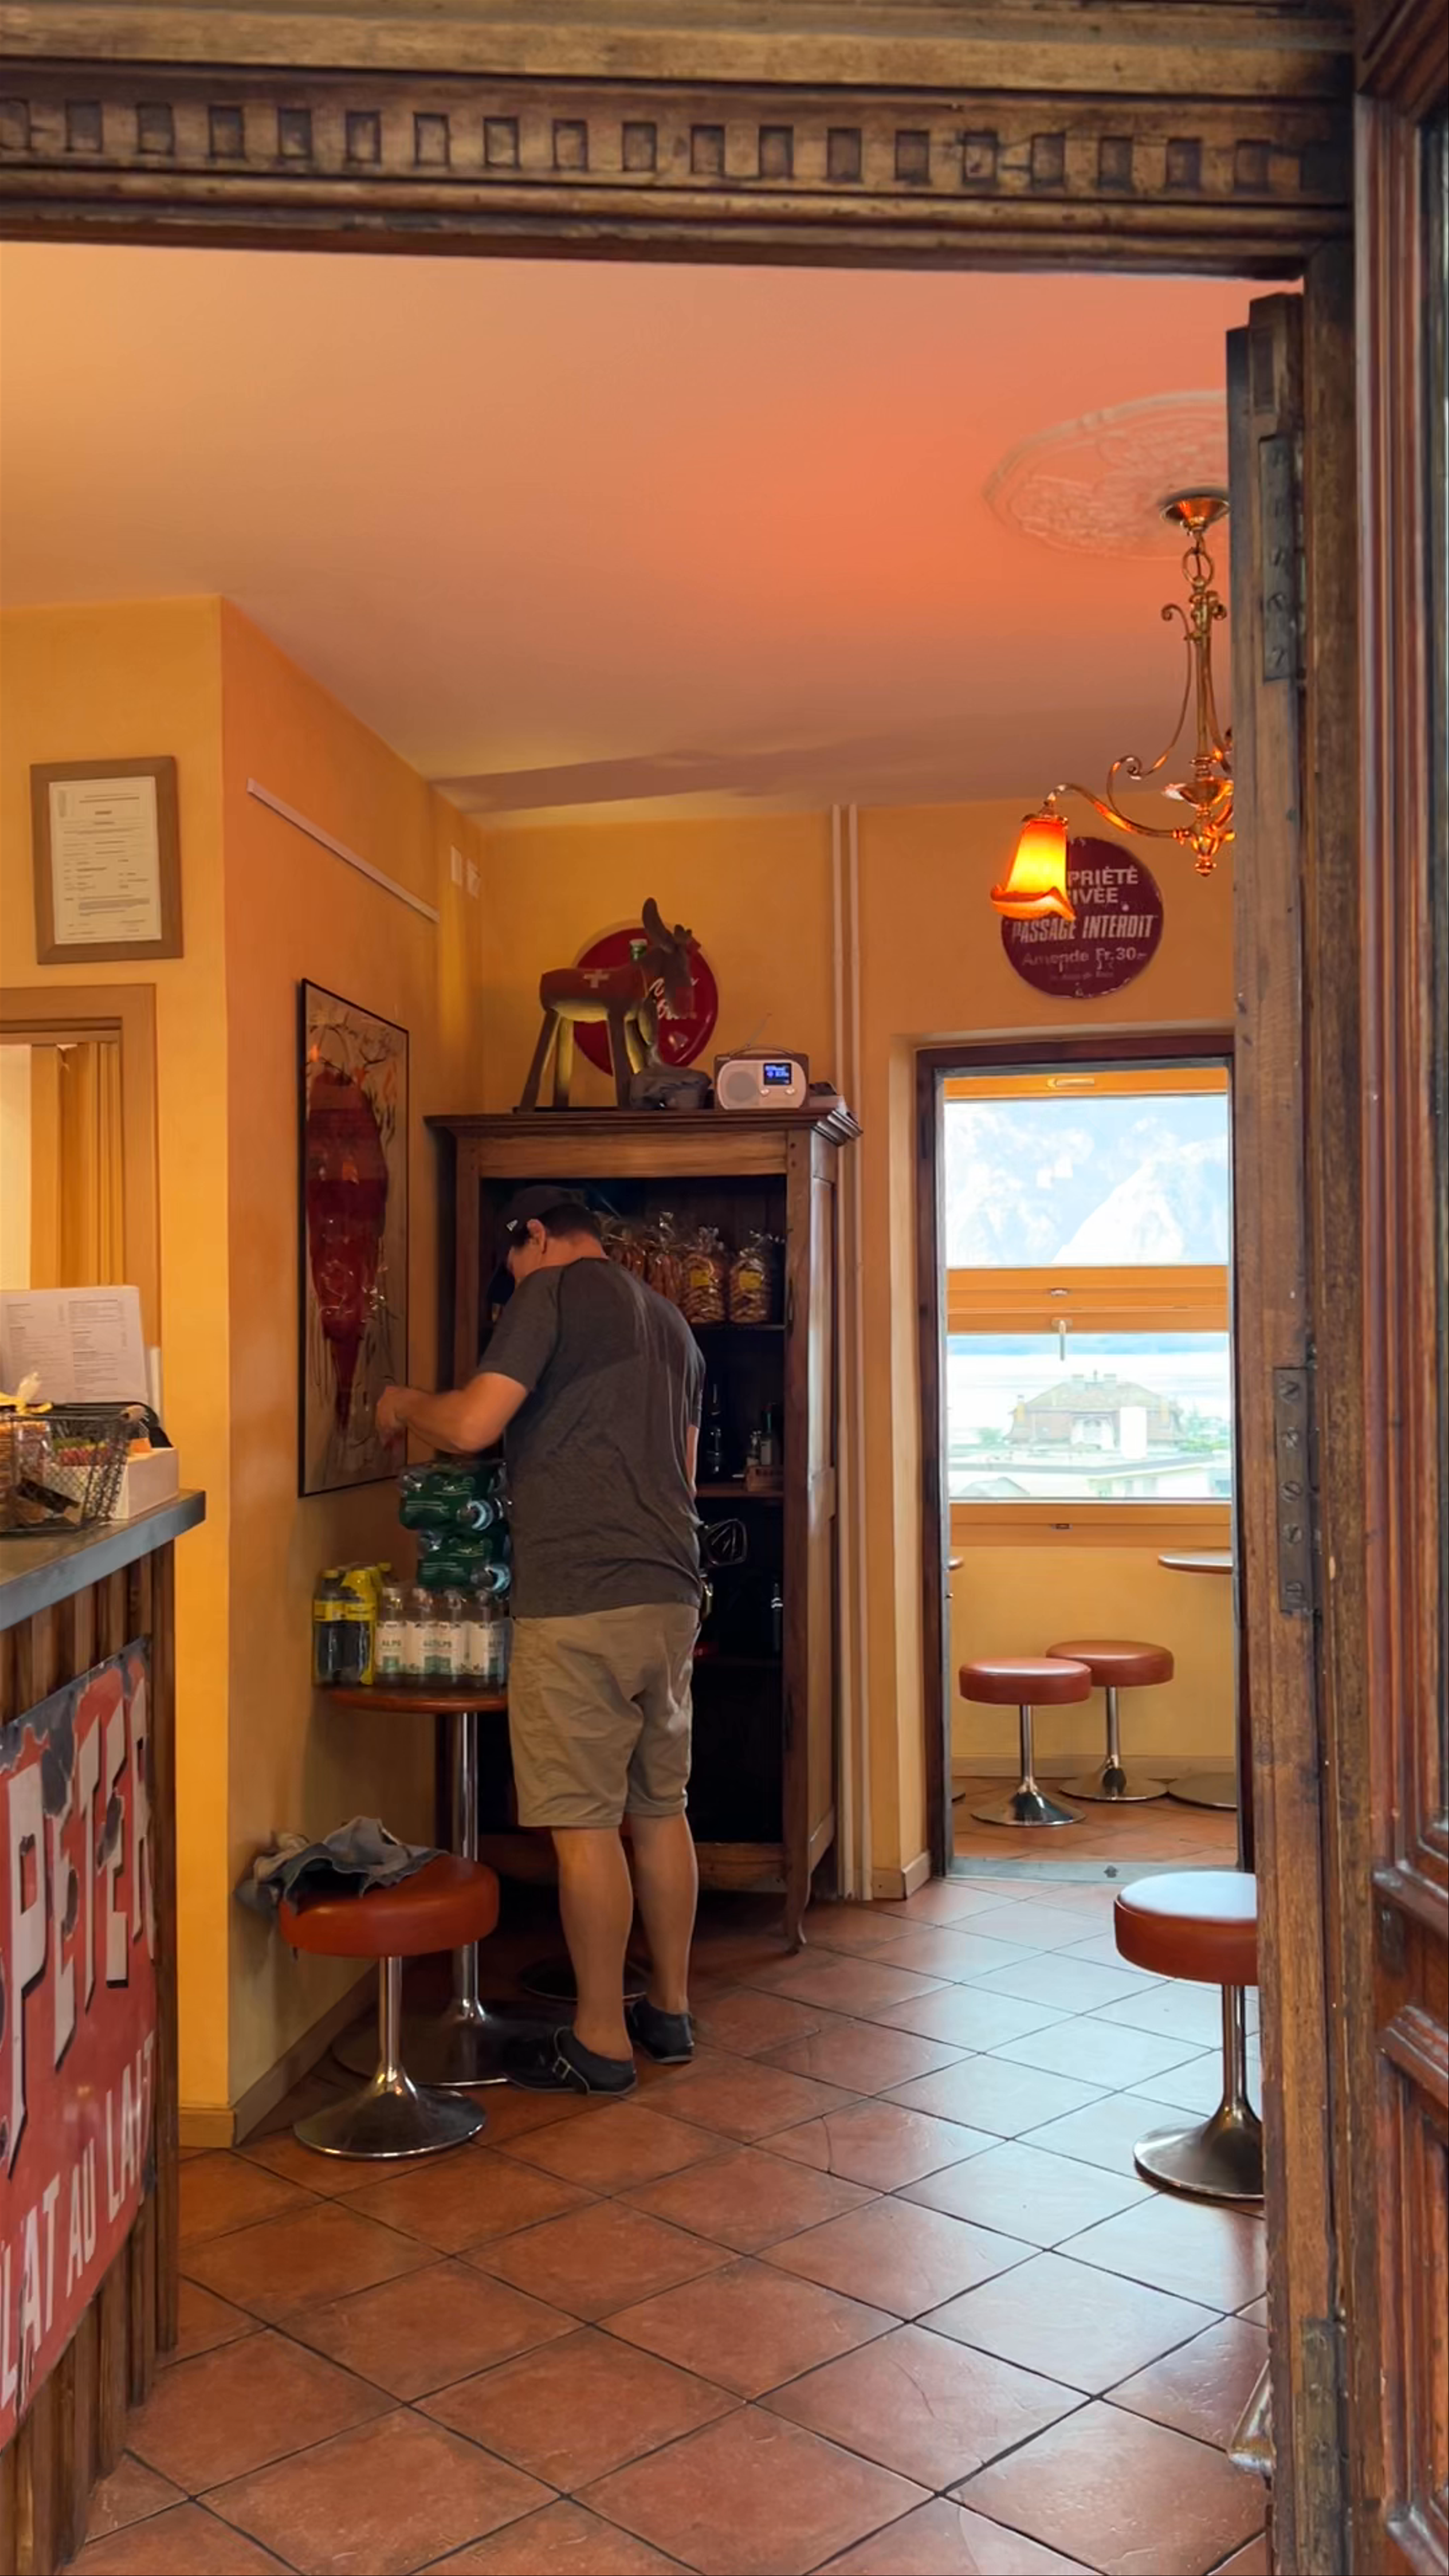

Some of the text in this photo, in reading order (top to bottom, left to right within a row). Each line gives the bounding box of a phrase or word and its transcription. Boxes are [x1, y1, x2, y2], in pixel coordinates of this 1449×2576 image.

[1068, 865, 1138, 887] PRIÉTÉ
[1070, 885, 1118, 905] IVÉE
[1012, 915, 1154, 943] PASSAGE INTERDIT
[1022, 949, 1090, 966] Amende
[8, 1675, 155, 2175] PETER
[66, 2137, 96, 2299] AU
[106, 2030, 154, 2223] LAIT
